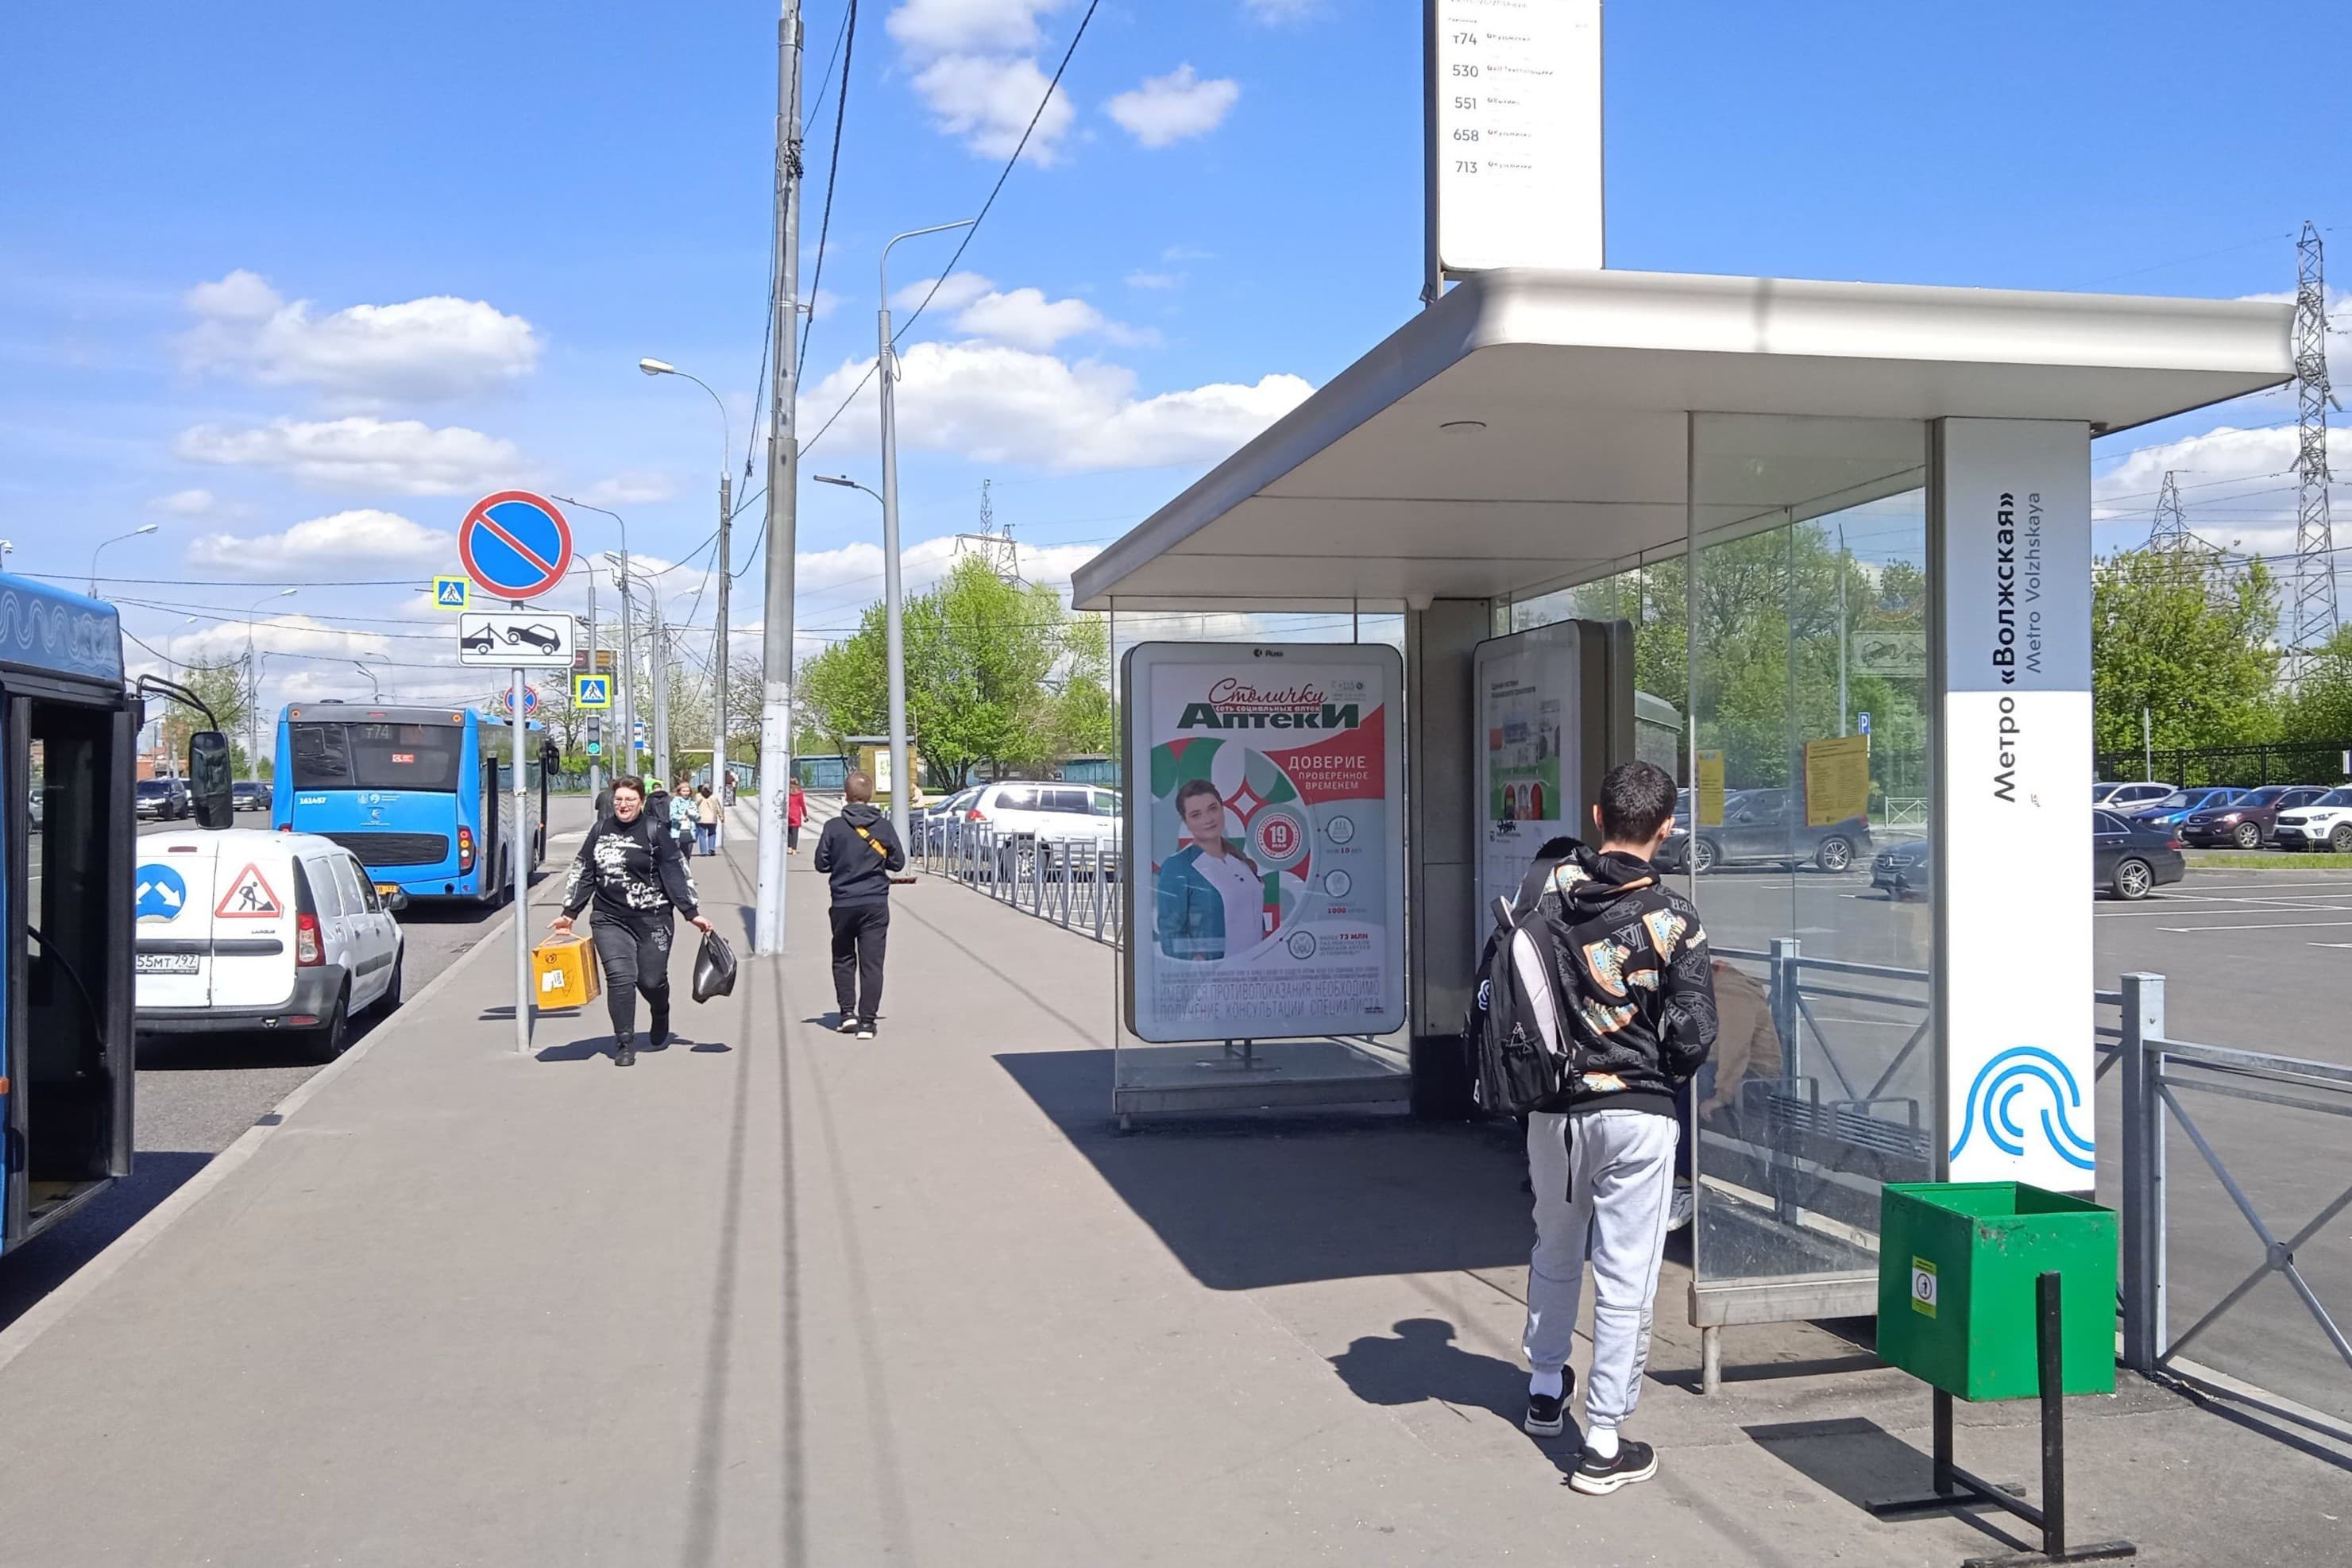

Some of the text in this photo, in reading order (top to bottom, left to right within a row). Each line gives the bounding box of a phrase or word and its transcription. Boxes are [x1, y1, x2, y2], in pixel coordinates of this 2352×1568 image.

[1452, 64, 1479, 78] 530
[1454, 96, 1477, 110] 551
[1453, 128, 1479, 142] 658
[1455, 160, 1477, 174] 713
[2024, 492, 2045, 674] Metro Volzhskaya
[1992, 492, 2020, 803] Метро «Волжская»
[1208, 678, 1328, 704] Столички
[1236, 705, 1293, 713] социальных
[1288, 755, 1366, 770] ДОВЕРИЕ
[1299, 771, 1369, 780] ПРОВЕРЕННОЕ
[1305, 781, 1359, 790] ВРЕМЕНЕМ
[1269, 825, 1287, 843] 19
[1211, 982, 1311, 1001] ПРОТИВОПОКАЗАНИЯ
[1315, 979, 1380, 998] НЕОБХОДИМО
[1226, 1000, 1304, 1018] КОНСУЛЬТАЦИИ
